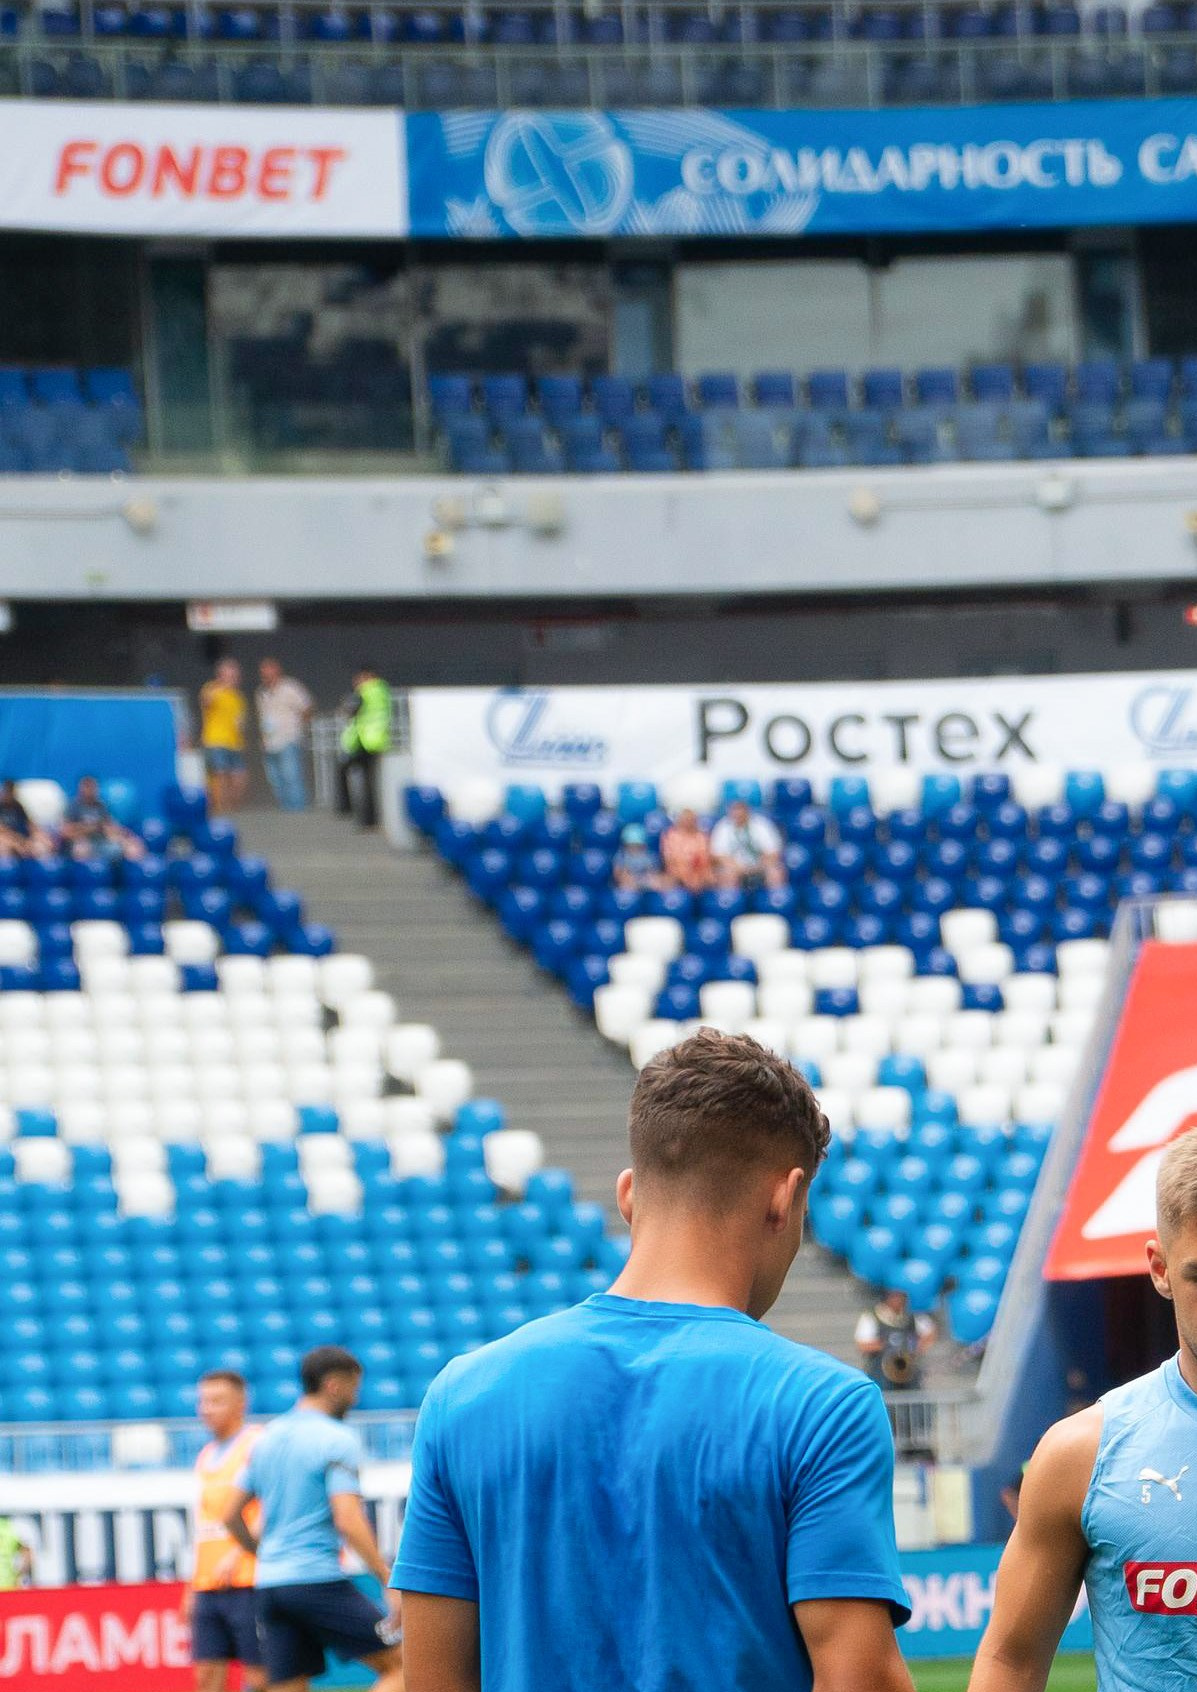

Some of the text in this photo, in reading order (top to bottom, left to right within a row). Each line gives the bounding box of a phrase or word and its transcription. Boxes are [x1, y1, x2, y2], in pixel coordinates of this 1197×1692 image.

[55, 141, 345, 201] FONBET
[681, 139, 1122, 196] СОЛИДАРНОСТЬ
[696, 700, 1038, 764] Ростех
